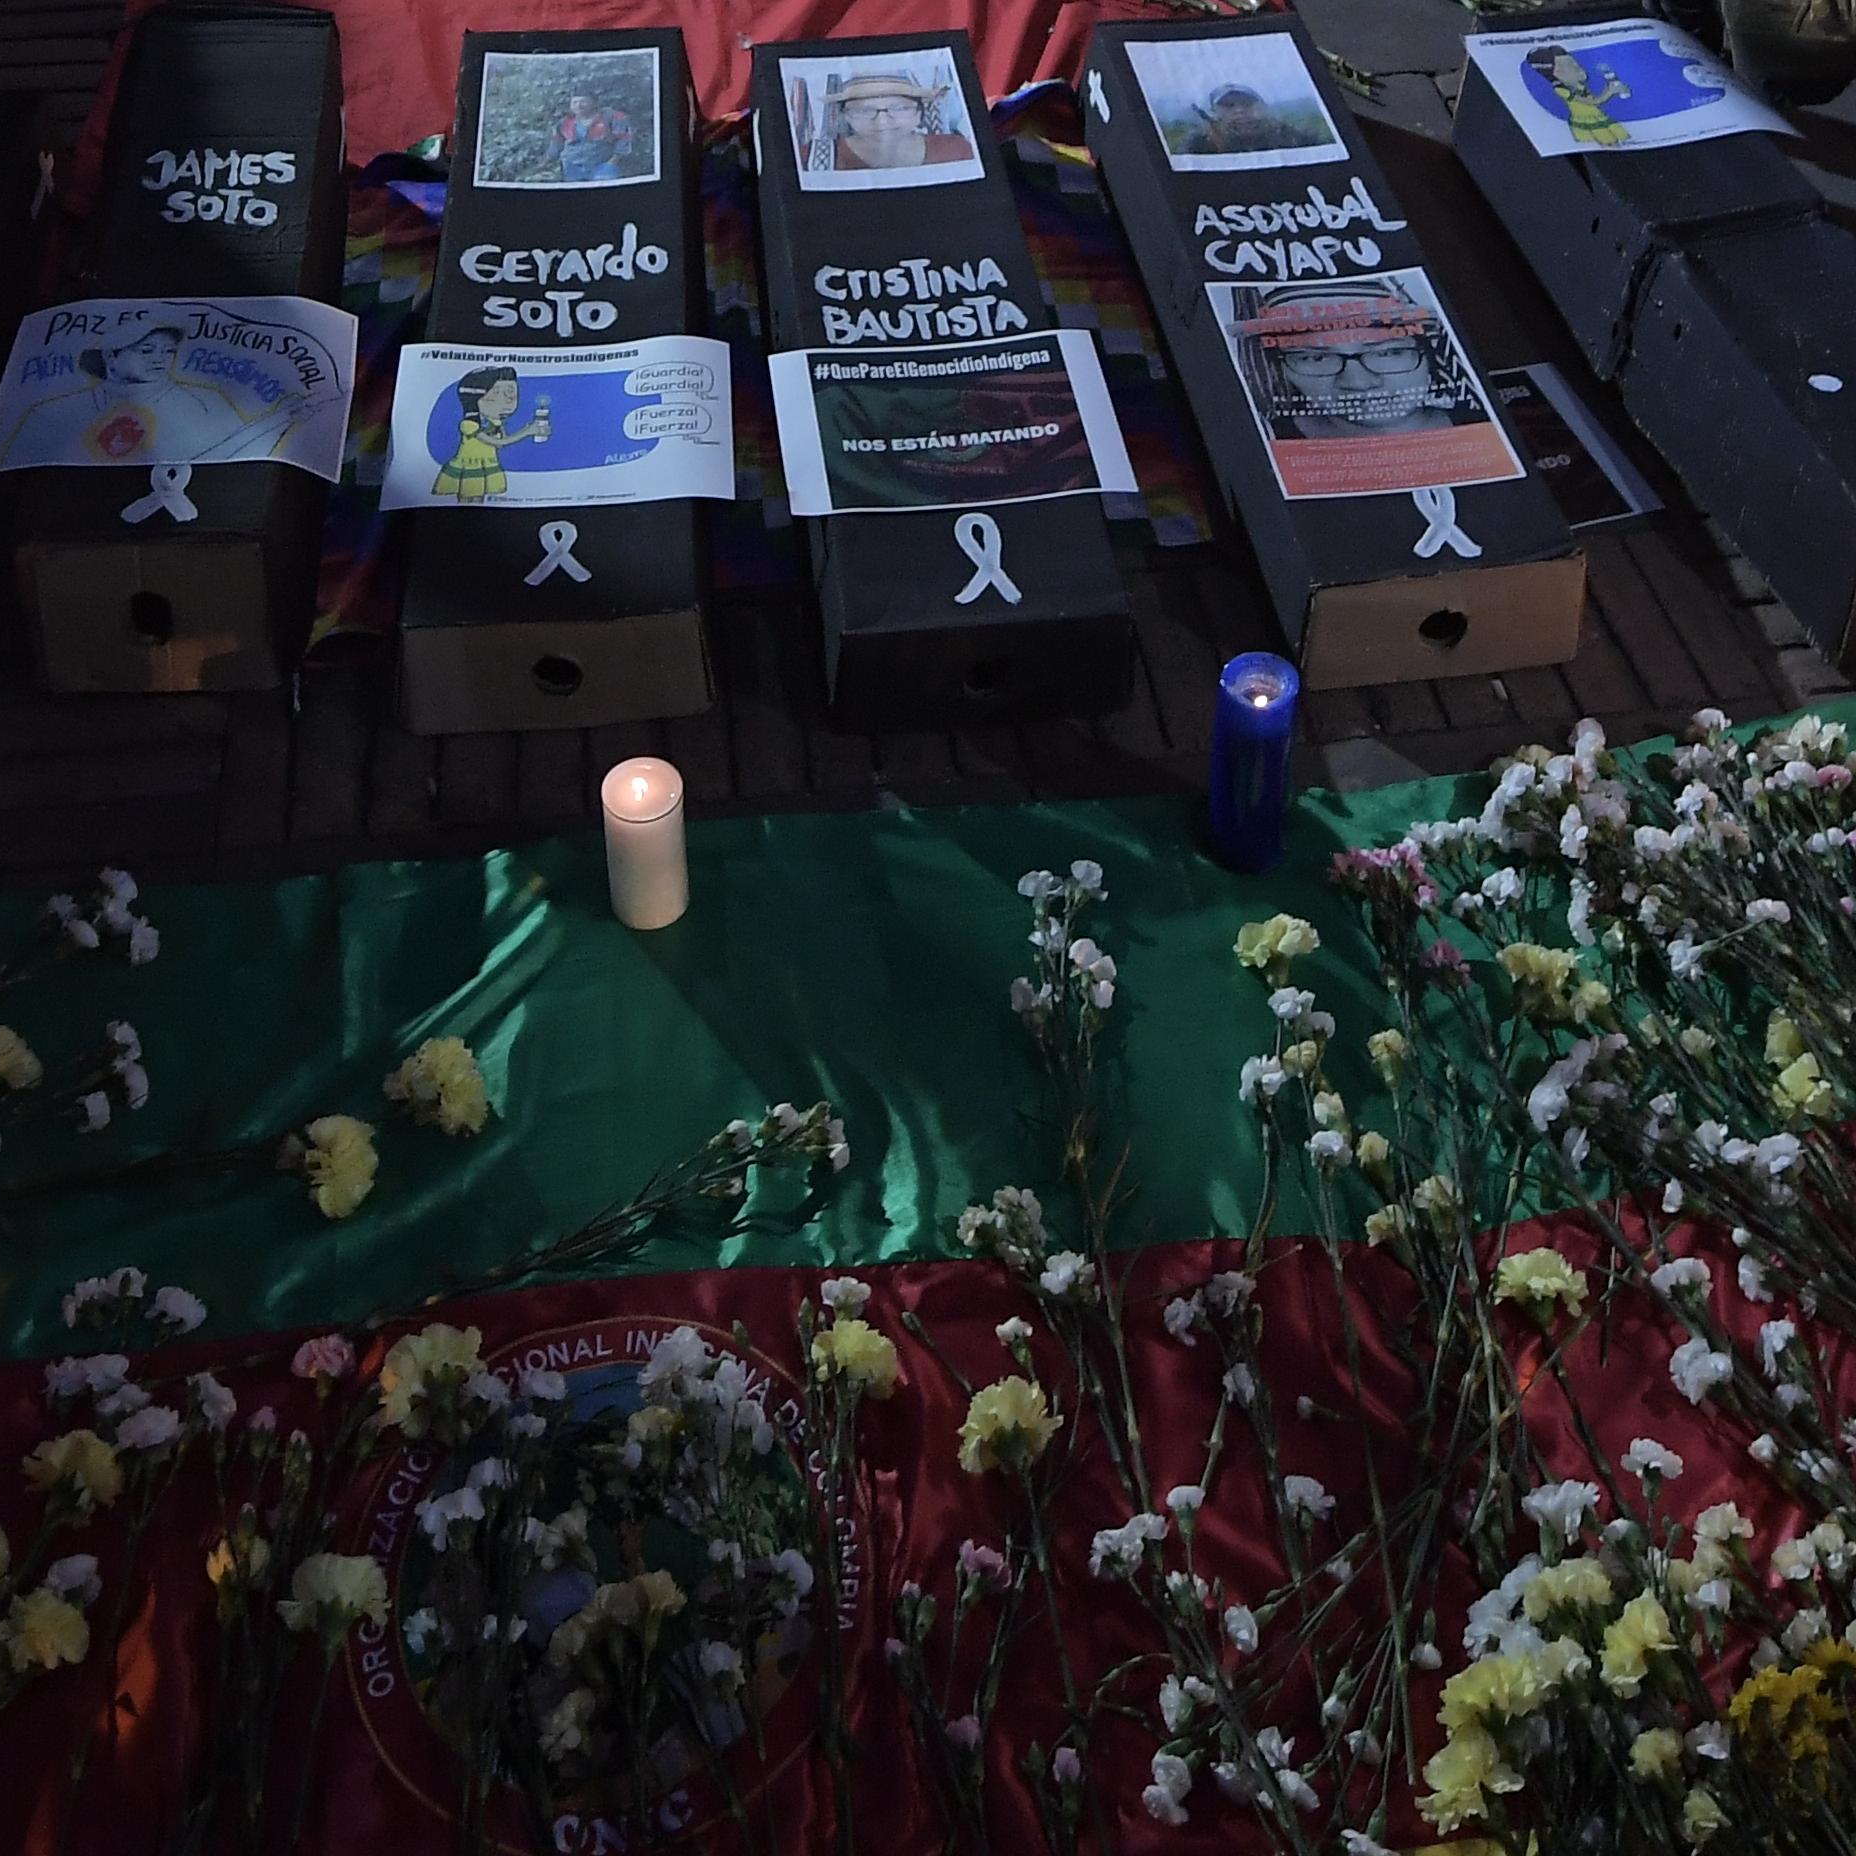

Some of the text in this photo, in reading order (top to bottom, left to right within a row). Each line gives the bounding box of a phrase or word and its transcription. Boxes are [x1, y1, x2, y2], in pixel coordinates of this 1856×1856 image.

[141, 147, 296, 190] JAMES
[160, 187, 279, 227] SOTO
[482, 289, 618, 338] SOTO
[822, 295, 1029, 345] BAUTISTA
[45, 309, 107, 345] PAZ
[187, 312, 273, 353] JUSTICIA
[275, 335, 326, 391] SOCIAL
[814, 347, 1052, 381] #QuePareElGenocidioIndígena
[842, 422, 1060, 454] NOS ESTÁN MATANDO
